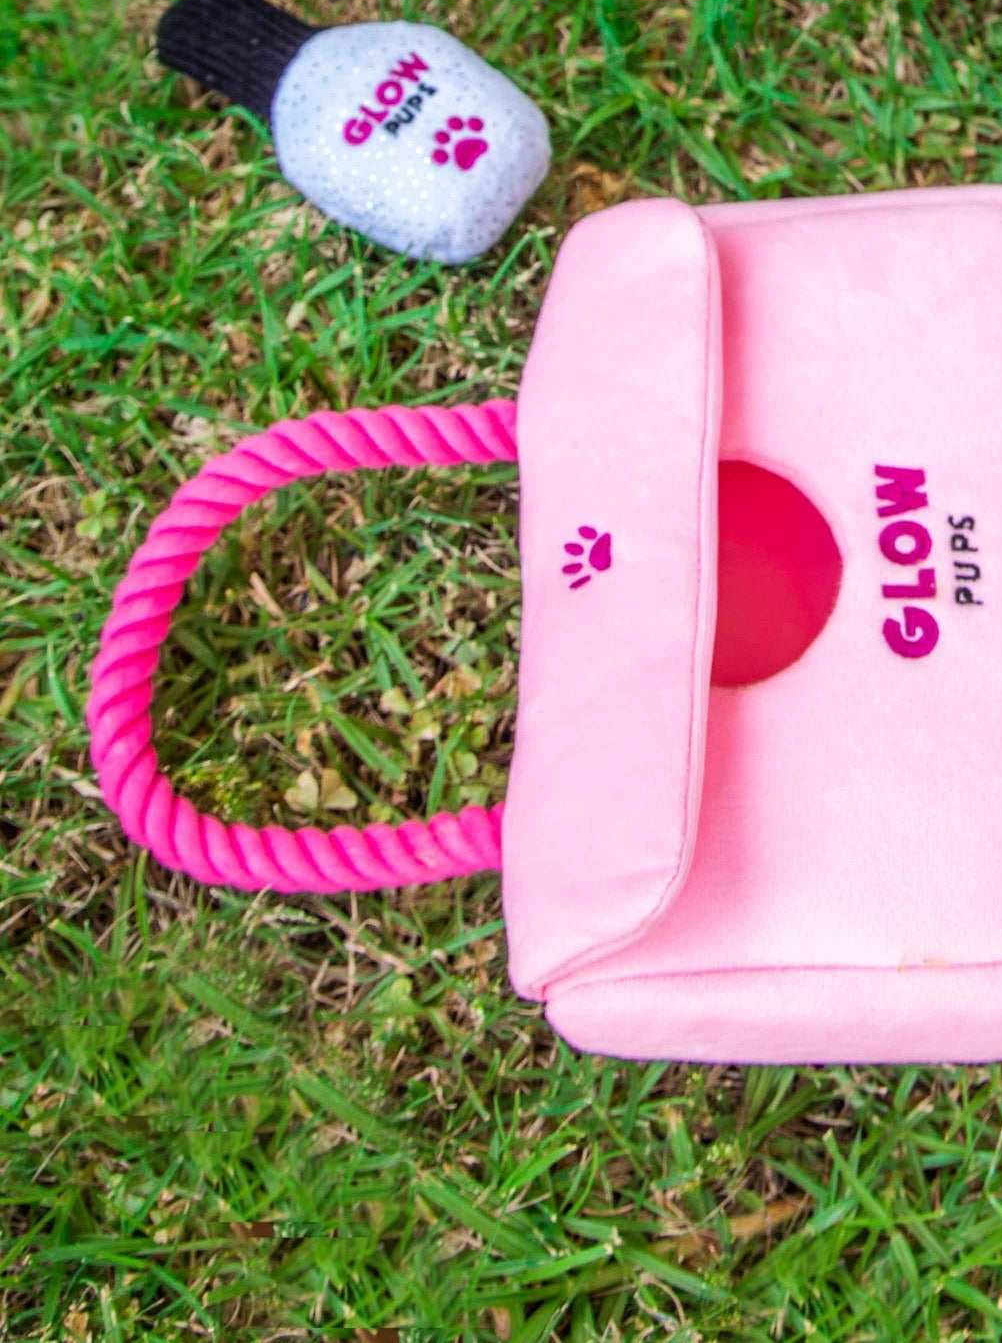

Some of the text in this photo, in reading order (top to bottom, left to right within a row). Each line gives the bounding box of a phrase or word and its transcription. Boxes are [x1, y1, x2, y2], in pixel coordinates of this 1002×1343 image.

[342, 52, 431, 146] GLOW
[383, 82, 438, 138] PUPS
[874, 464, 940, 659] GLOW
[948, 514, 983, 606] PUPS
